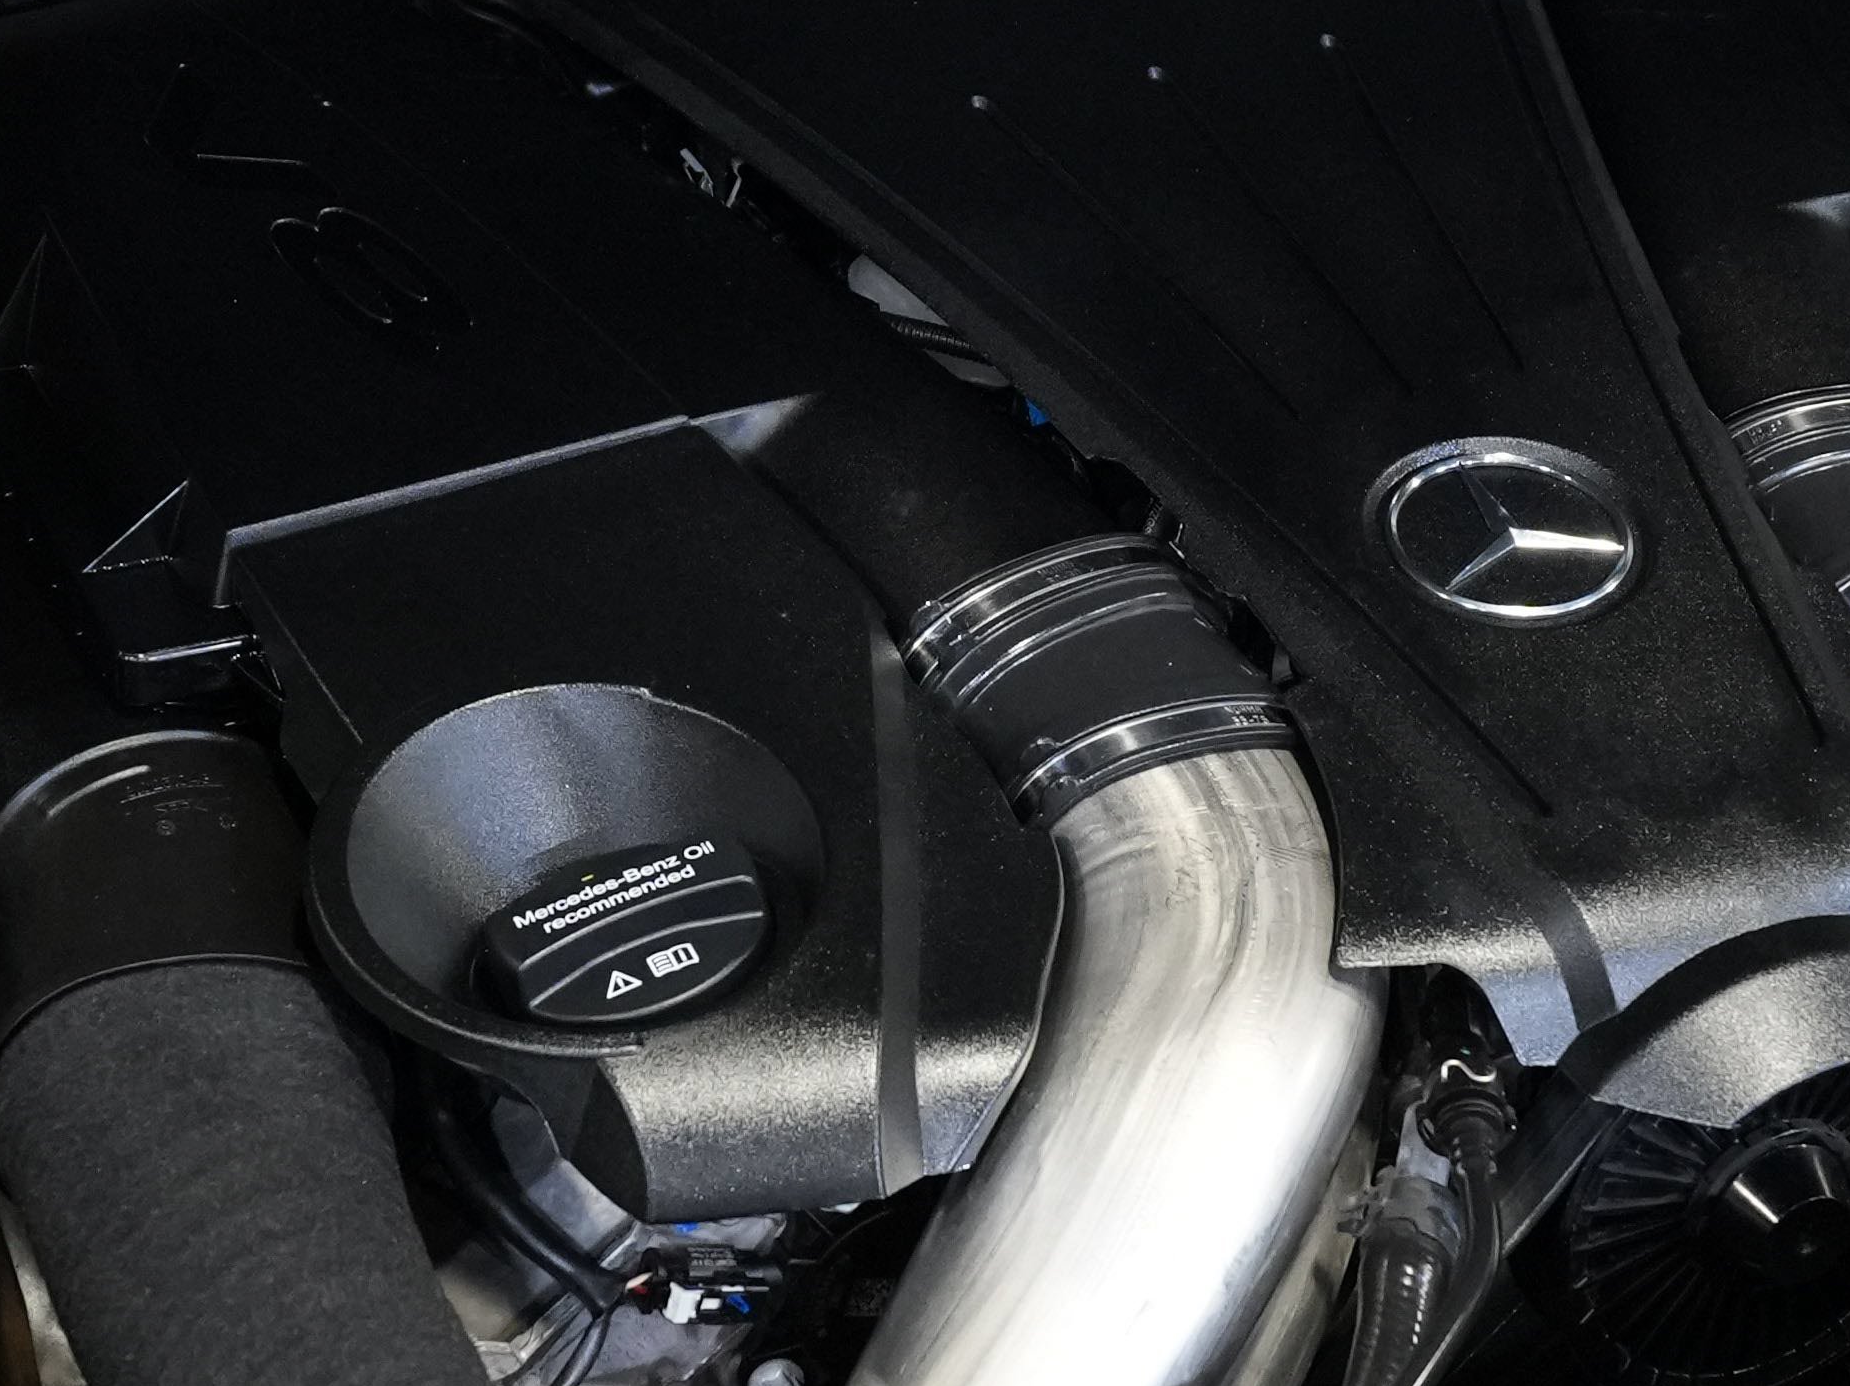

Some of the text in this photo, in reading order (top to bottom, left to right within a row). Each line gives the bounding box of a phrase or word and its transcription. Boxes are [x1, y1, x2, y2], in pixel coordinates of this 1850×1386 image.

[513, 840, 715, 930] Mercedes-Benz Oil
[543, 864, 696, 934] recommended
